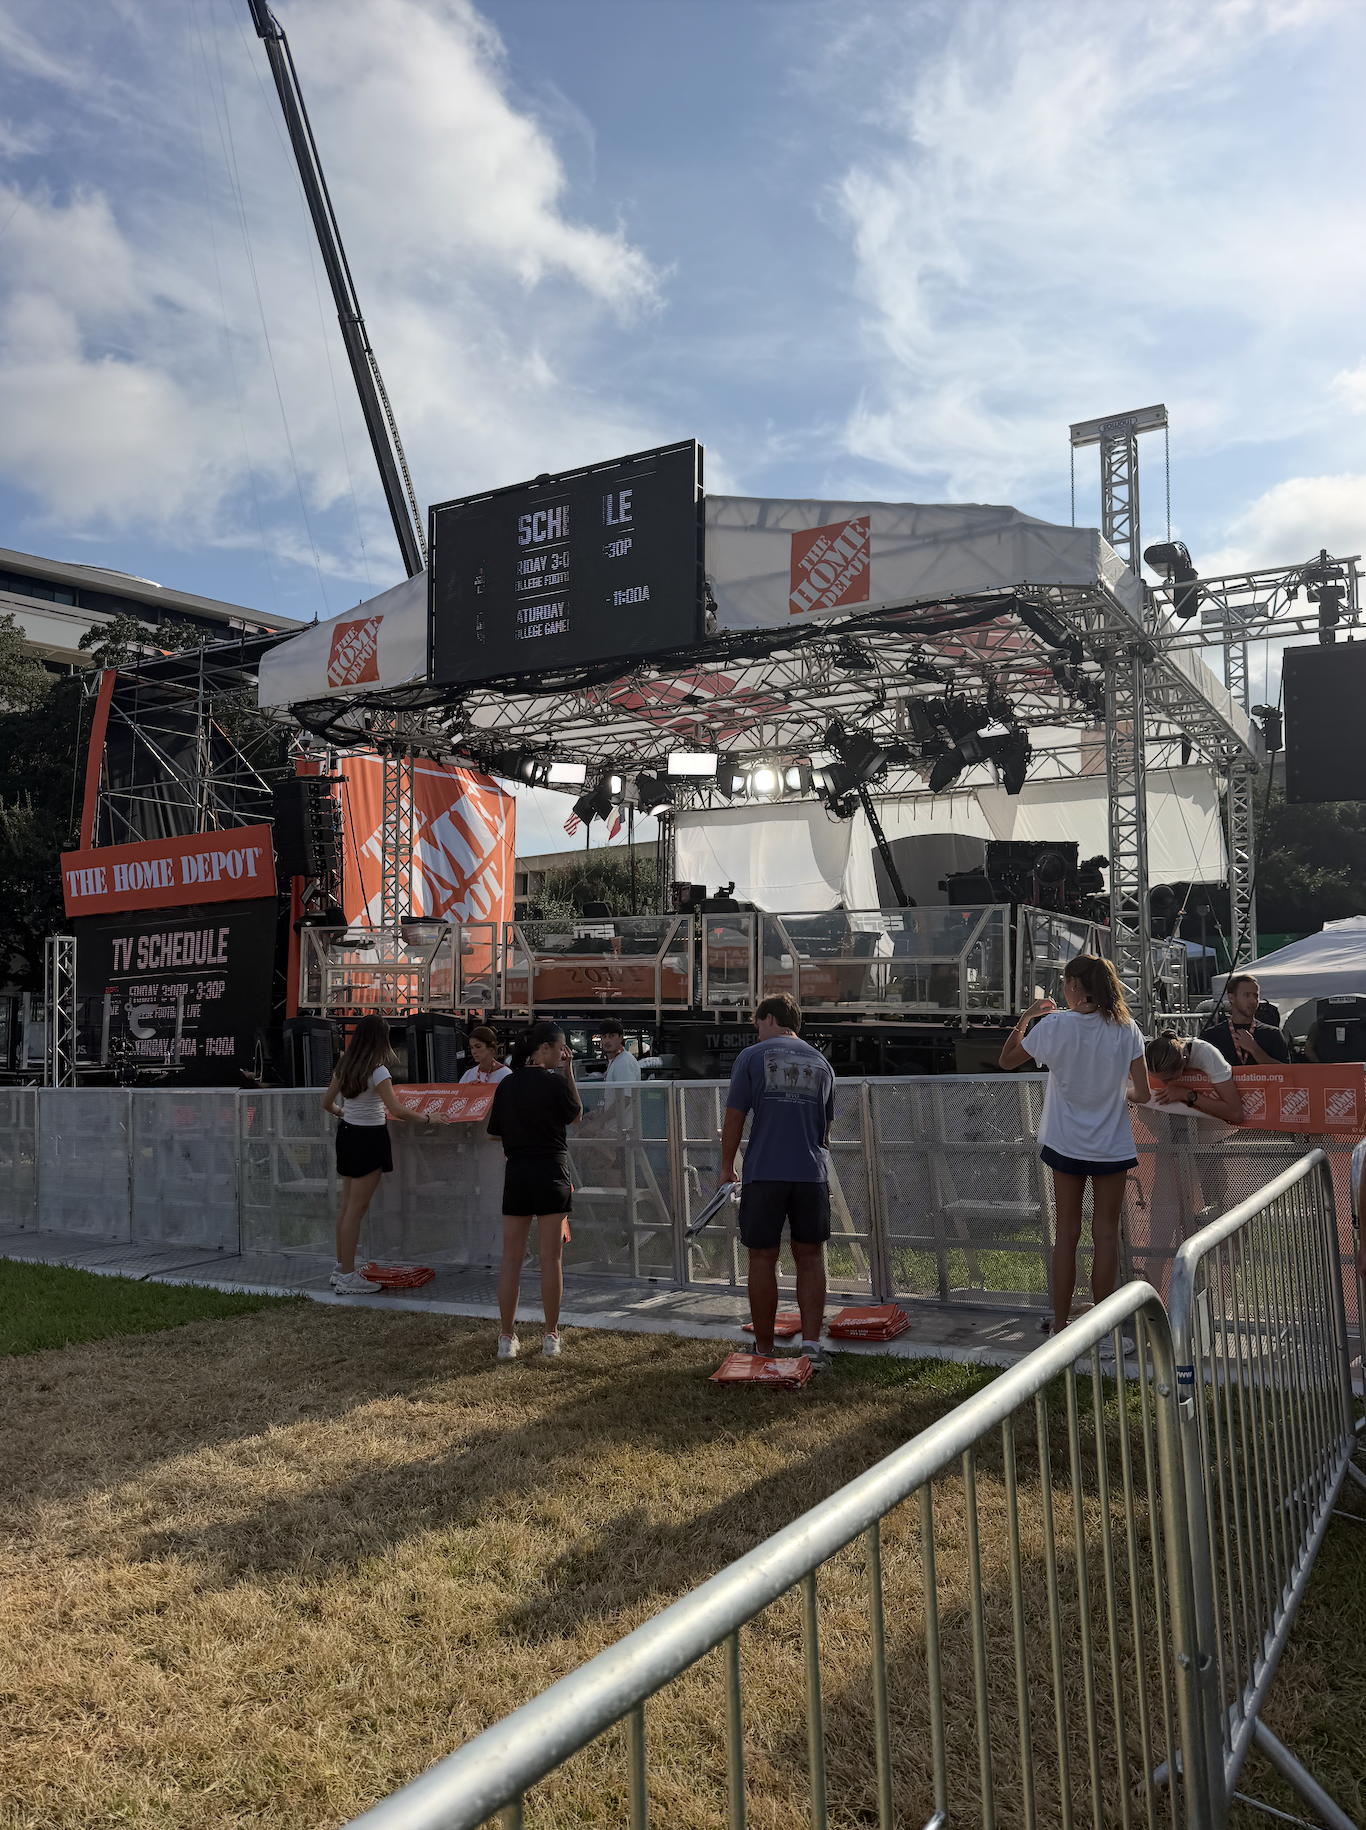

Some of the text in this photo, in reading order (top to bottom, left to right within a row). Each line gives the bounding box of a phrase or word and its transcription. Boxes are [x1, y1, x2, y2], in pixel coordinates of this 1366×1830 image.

[789, 518, 871, 612] HOME
[797, 534, 832, 572] THE
[820, 549, 871, 608] DEPOT
[327, 617, 382, 686] HOME
[334, 626, 358, 654] THE
[347, 637, 378, 684] DEPOT
[66, 846, 260, 898] THE HOME DEPOT
[112, 927, 230, 972] TV SCHEDULE
[128, 983, 159, 1004] FRIDAY
[196, 979, 226, 1001] 3:30P
[205, 1035, 235, 1057] 11:00A
[706, 1034, 721, 1048] TV
[1280, 1088, 1309, 1116] HOME
[1325, 1089, 1356, 1117] HOME
